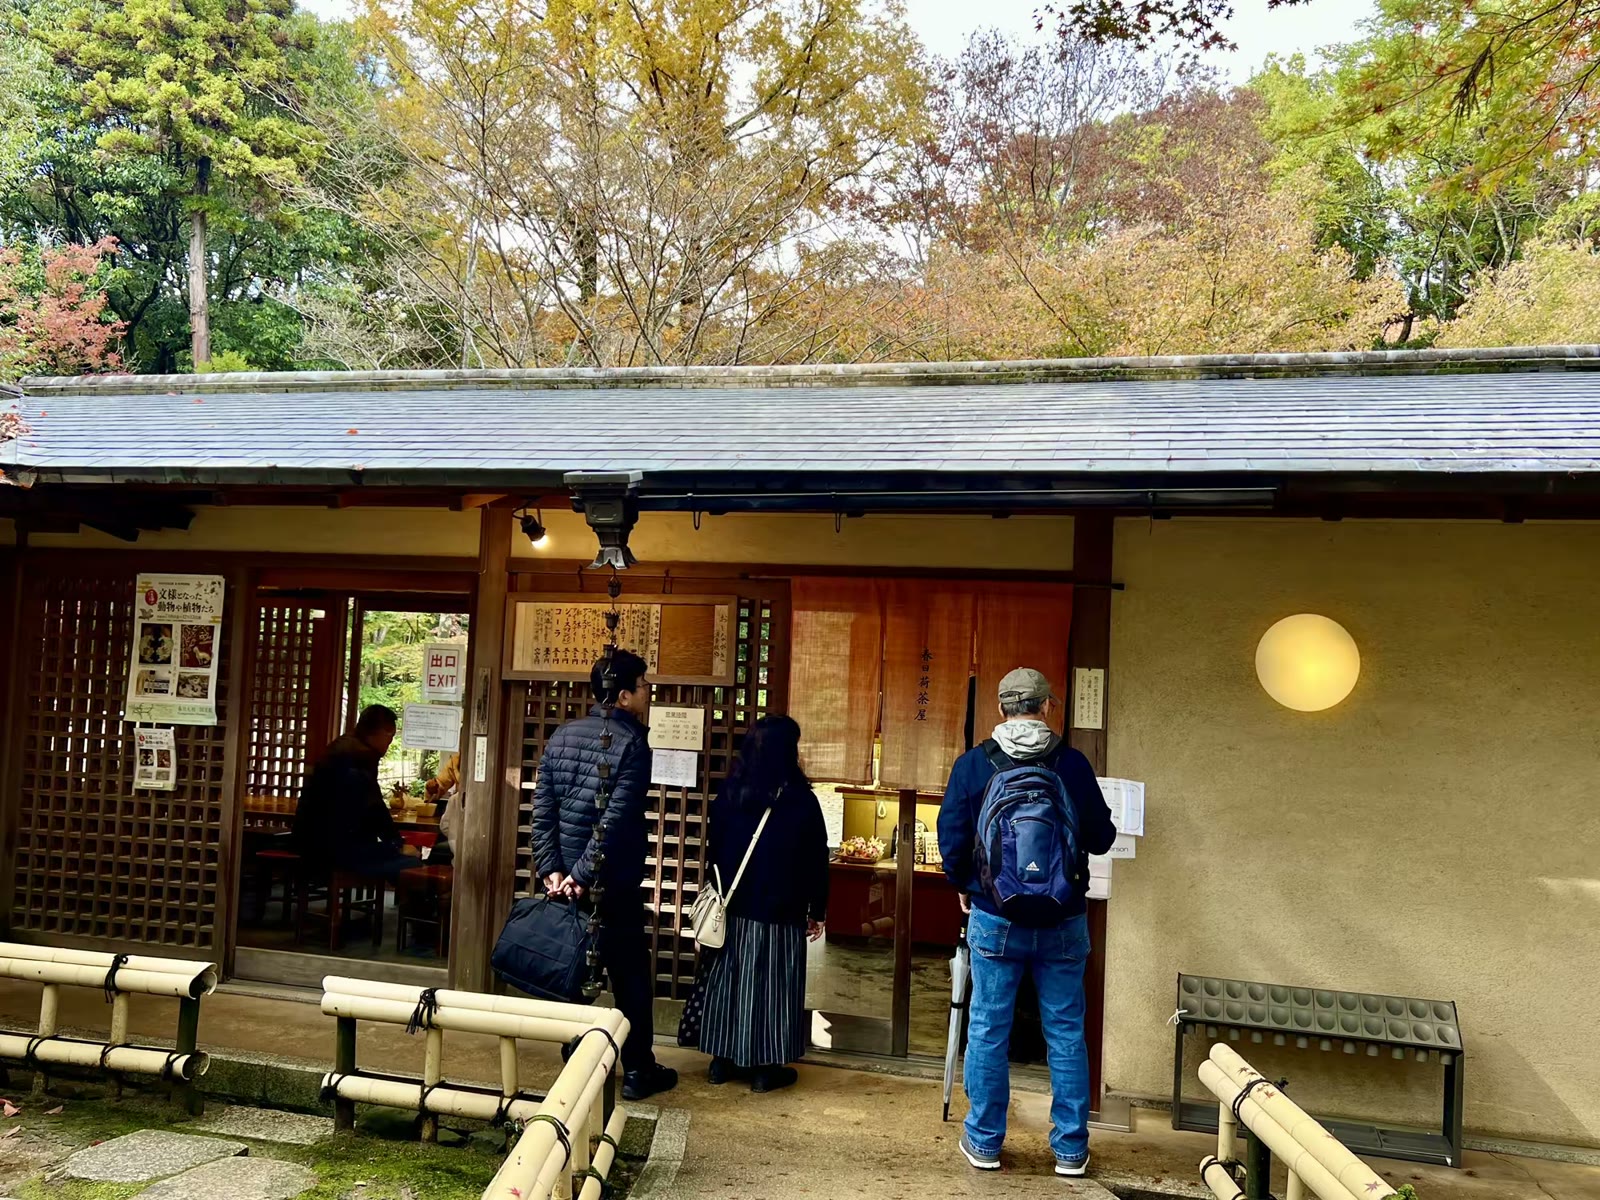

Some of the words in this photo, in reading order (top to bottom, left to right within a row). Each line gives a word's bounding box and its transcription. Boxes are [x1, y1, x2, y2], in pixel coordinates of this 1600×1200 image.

[159, 588, 202, 601] 文様となった
[157, 601, 214, 613] 動物や植物たち
[554, 608, 562, 638] コーラ
[430, 654, 456, 668] 出口
[428, 674, 457, 687] EXIT
[914, 648, 934, 721] 春日荷茶屋
